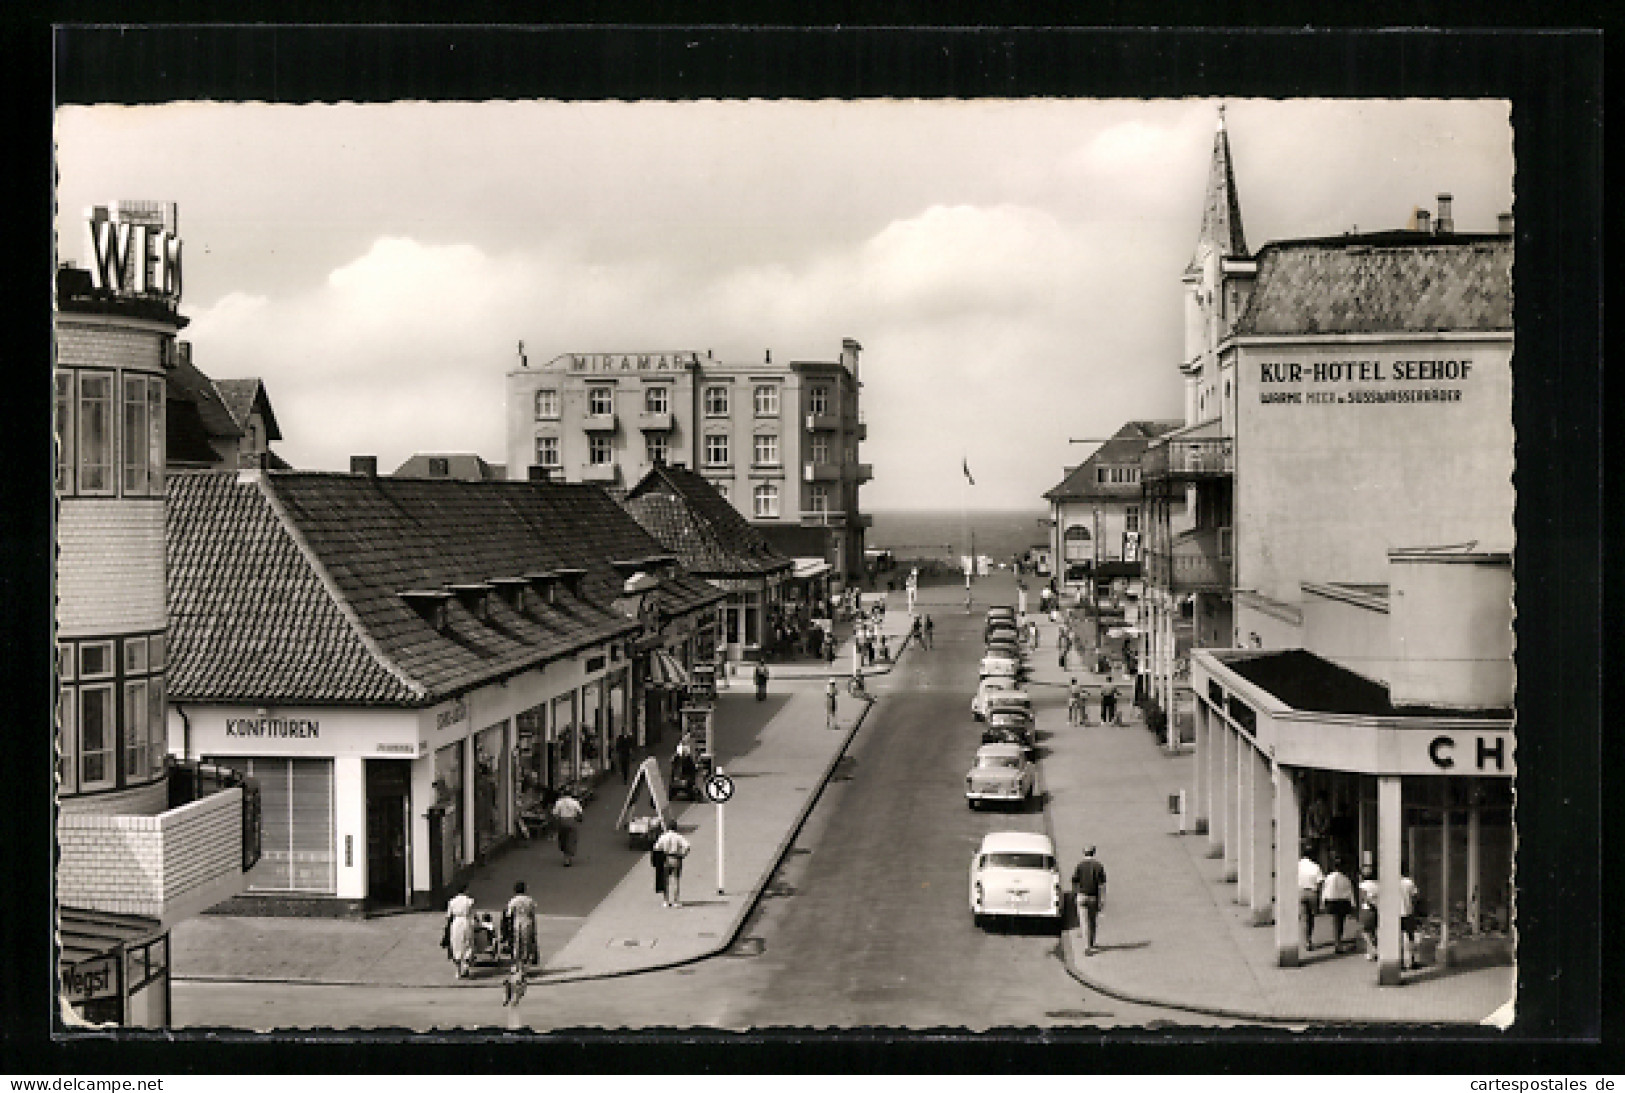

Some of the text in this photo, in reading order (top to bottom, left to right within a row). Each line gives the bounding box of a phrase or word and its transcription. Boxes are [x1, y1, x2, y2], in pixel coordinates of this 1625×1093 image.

[572, 354, 683, 371] MIRAMAR
[1260, 360, 1472, 383] KUR-HOTEL SEEHOF
